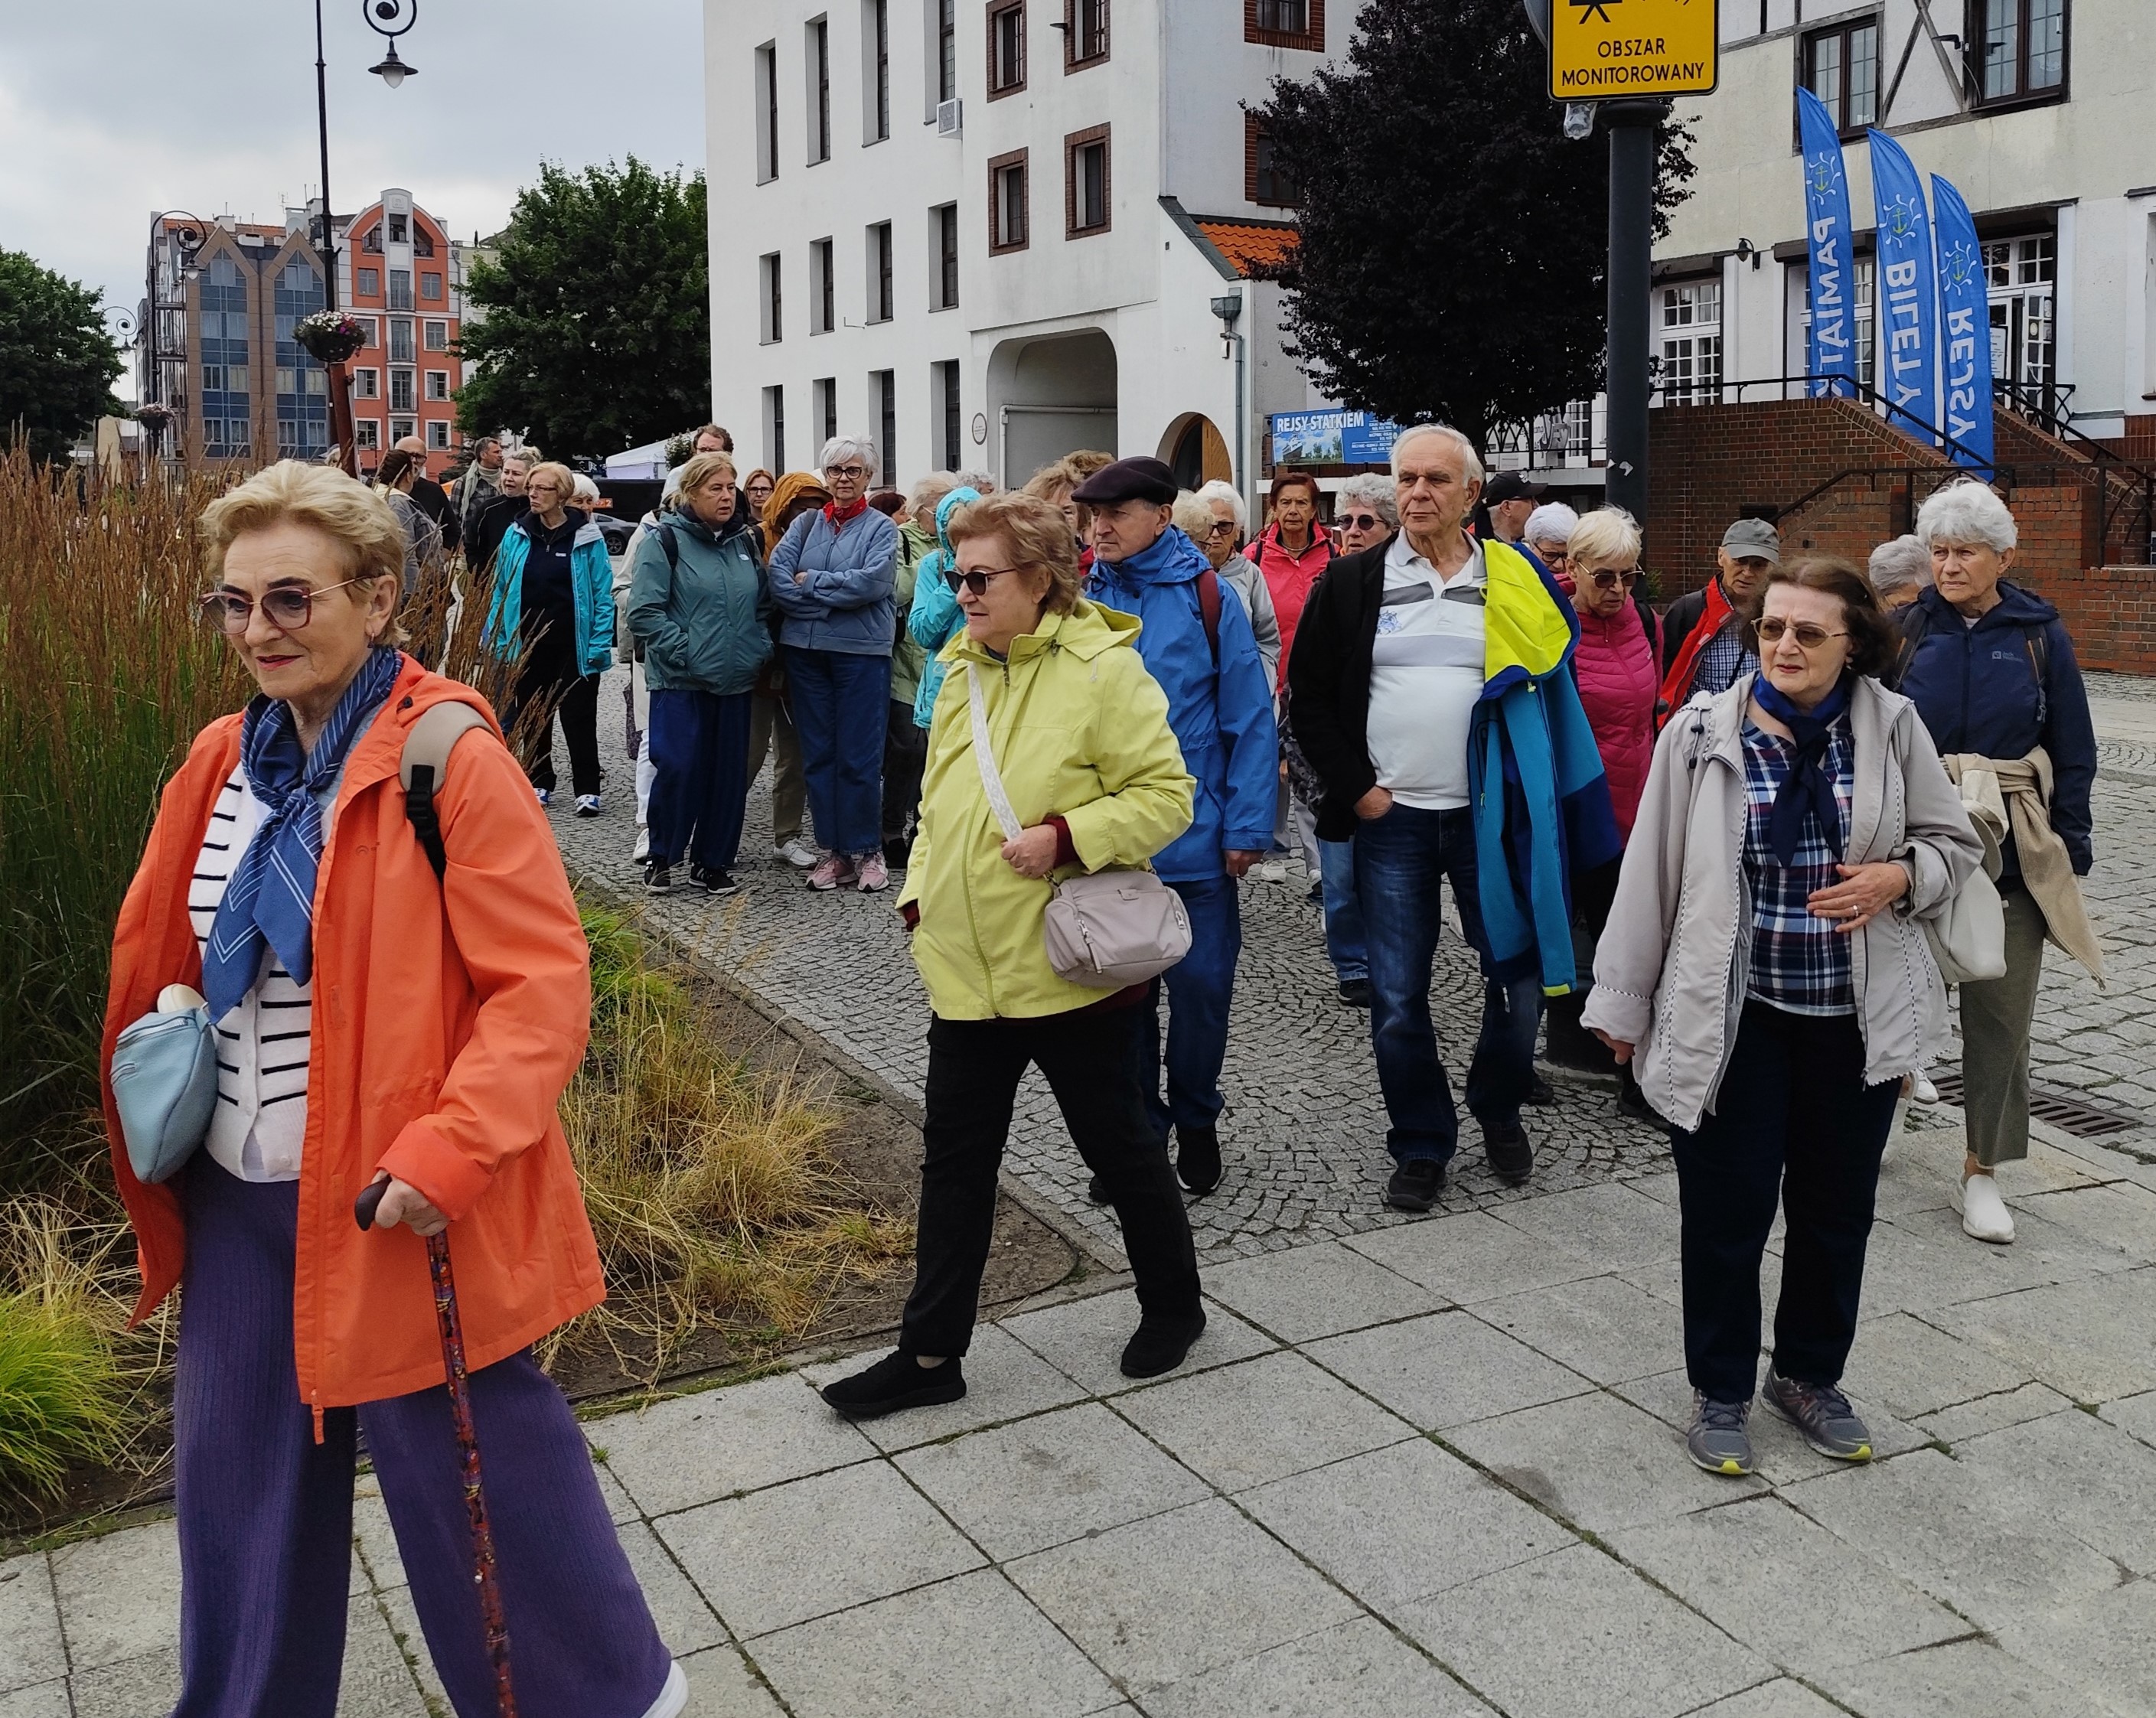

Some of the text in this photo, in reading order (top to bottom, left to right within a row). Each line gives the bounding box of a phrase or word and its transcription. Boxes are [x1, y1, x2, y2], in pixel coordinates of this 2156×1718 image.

[1597, 38, 1665, 58] OBSZAR
[1561, 62, 1704, 86] MONITOROWANY
[1277, 412, 1364, 432] REJSY STATKIEM
